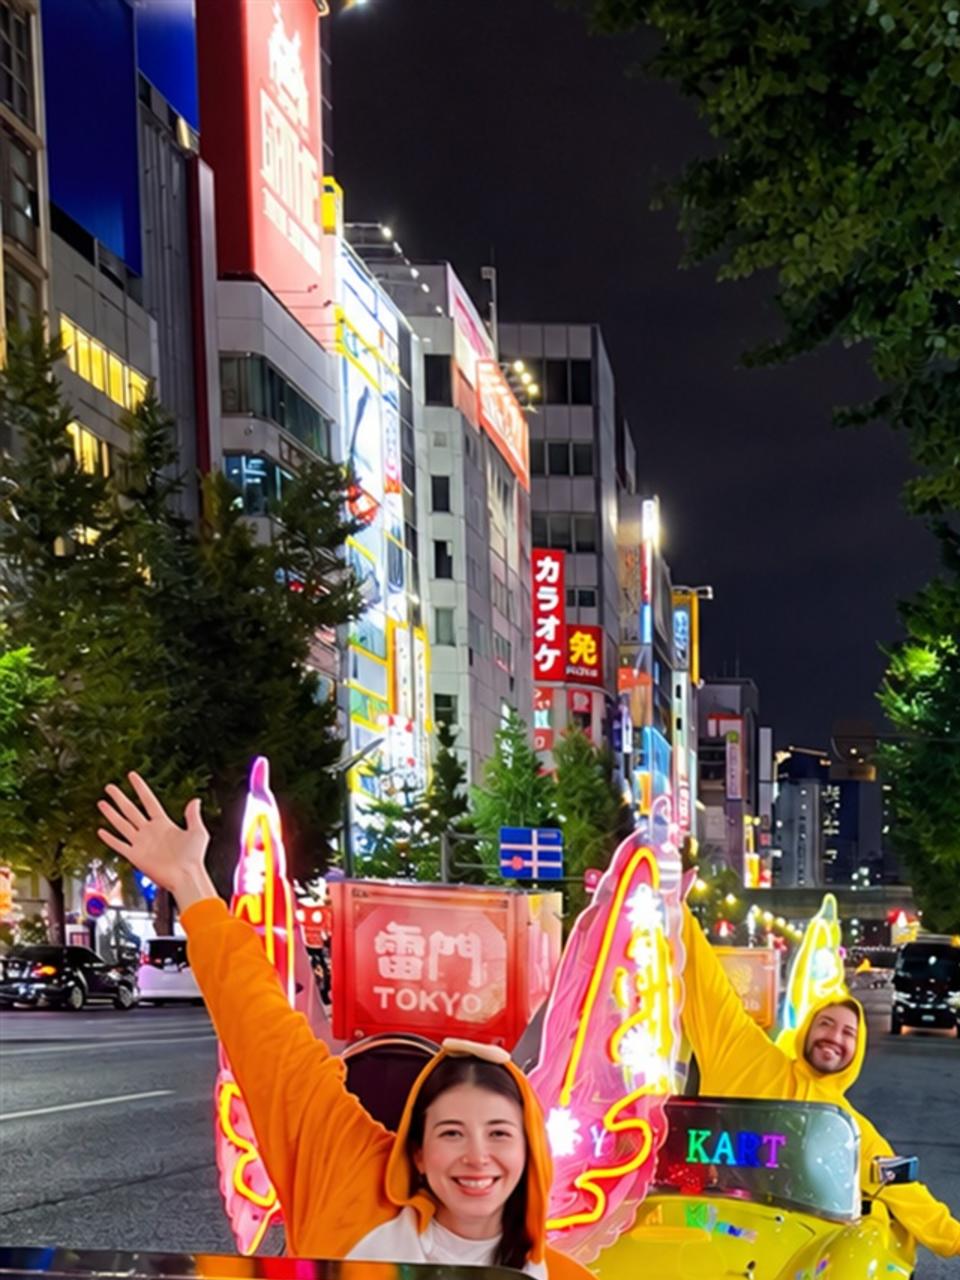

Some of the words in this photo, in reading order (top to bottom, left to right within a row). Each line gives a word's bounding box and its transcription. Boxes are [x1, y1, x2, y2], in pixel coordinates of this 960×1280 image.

[535, 556, 561, 672] カラオケ
[374, 921, 483, 988] 雷門
[373, 986, 482, 1017] TOKYO
[686, 1128, 786, 1168] KART
